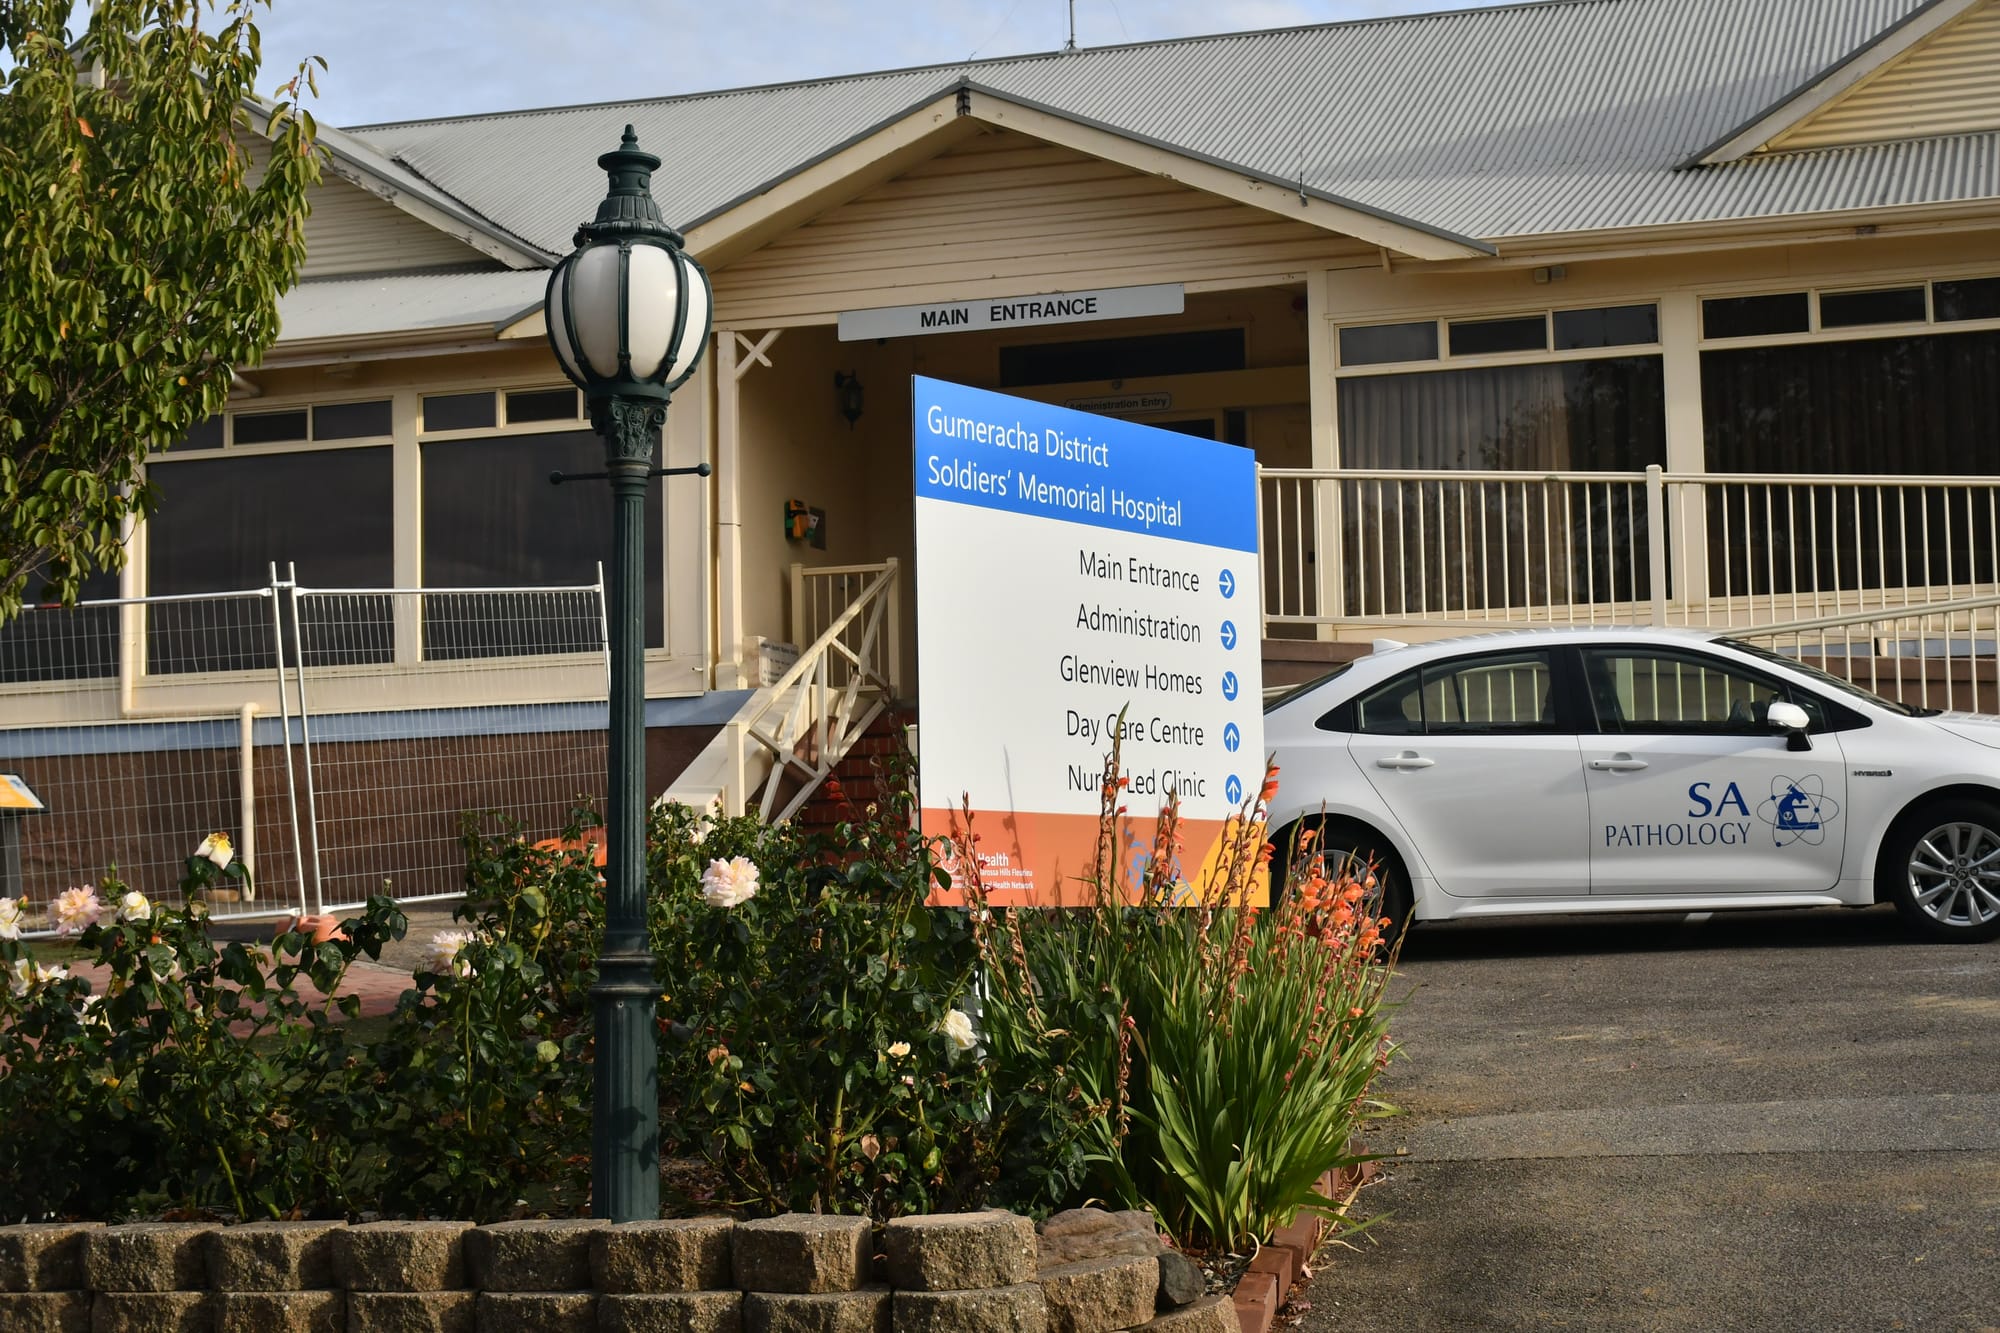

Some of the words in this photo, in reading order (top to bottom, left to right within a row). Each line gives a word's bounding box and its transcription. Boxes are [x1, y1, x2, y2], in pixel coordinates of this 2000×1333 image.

[921, 308, 969, 328] MAIN
[990, 297, 1097, 322] ENTRANCE
[1069, 400, 1139, 411] Administration
[1141, 398, 1167, 409] Entry
[928, 405, 1039, 454] Gumeracha
[1045, 429, 1109, 468] District
[928, 455, 1011, 496] Soldiers’
[1018, 471, 1105, 513] Memorial
[1112, 489, 1182, 529] Hospital
[1080, 549, 1122, 581] Main
[1129, 557, 1200, 592] Entrance
[1076, 603, 1201, 643] Administration
[1060, 655, 1139, 688] Glenview
[1145, 664, 1203, 695] Homes
[1067, 710, 1100, 746] Day
[1106, 713, 1144, 742] Care
[1150, 717, 1204, 746] Centre
[1068, 764, 1116, 792] Nur
[1127, 768, 1155, 795] Led
[1162, 770, 1206, 798] Clinic
[1688, 781, 1750, 818] SA
[1605, 822, 1751, 848] PATHOLOGY
[977, 852, 1009, 867] Health
[999, 868, 1011, 877] Hills
[992, 880, 1011, 889] Health
[1011, 880, 1034, 889] Network
